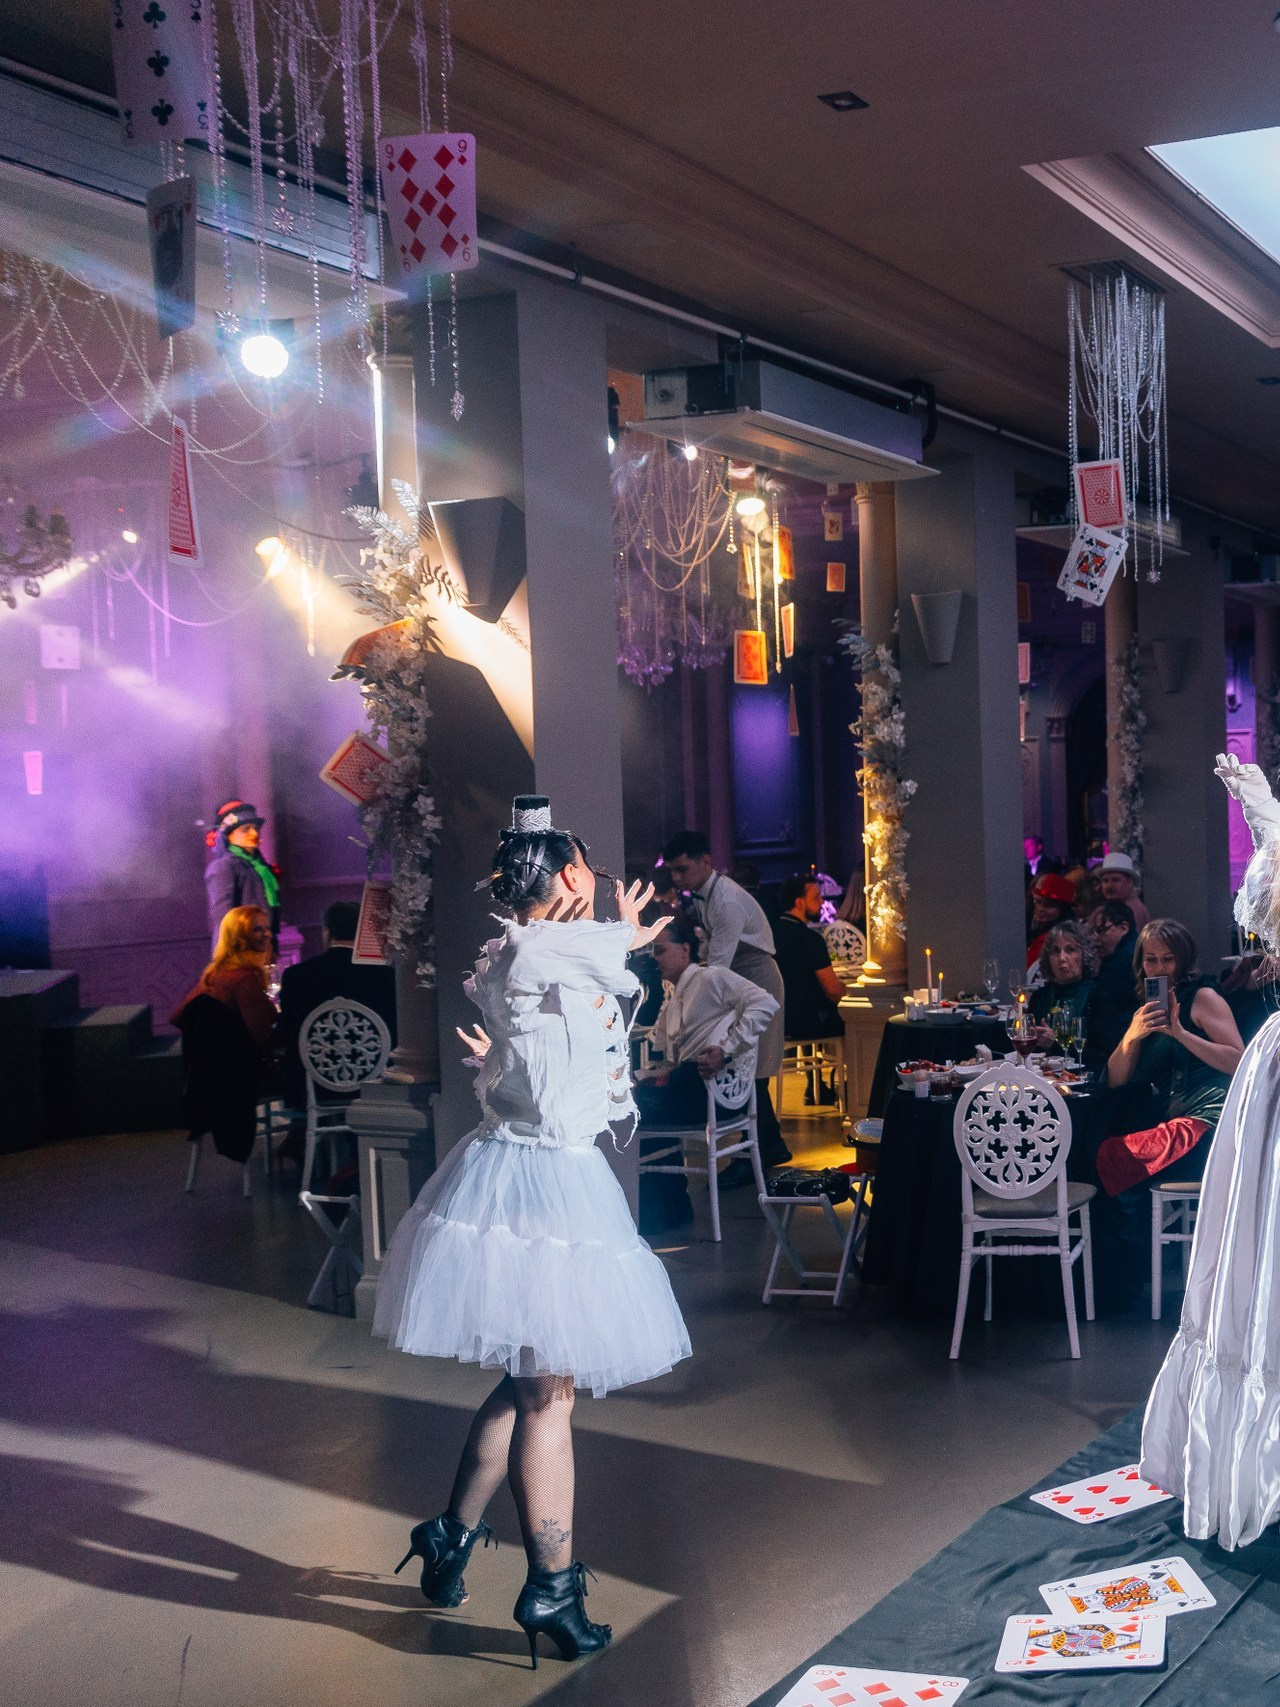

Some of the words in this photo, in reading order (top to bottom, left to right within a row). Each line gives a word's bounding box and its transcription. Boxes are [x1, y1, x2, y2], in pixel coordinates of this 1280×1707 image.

[384, 144, 394, 158] 9
[457, 139, 468, 153] 9
[462, 247, 471, 261] 9
[403, 258, 411, 272] 9
[1047, 1585, 1064, 1593] K
[942, 1680, 959, 1688] 8
